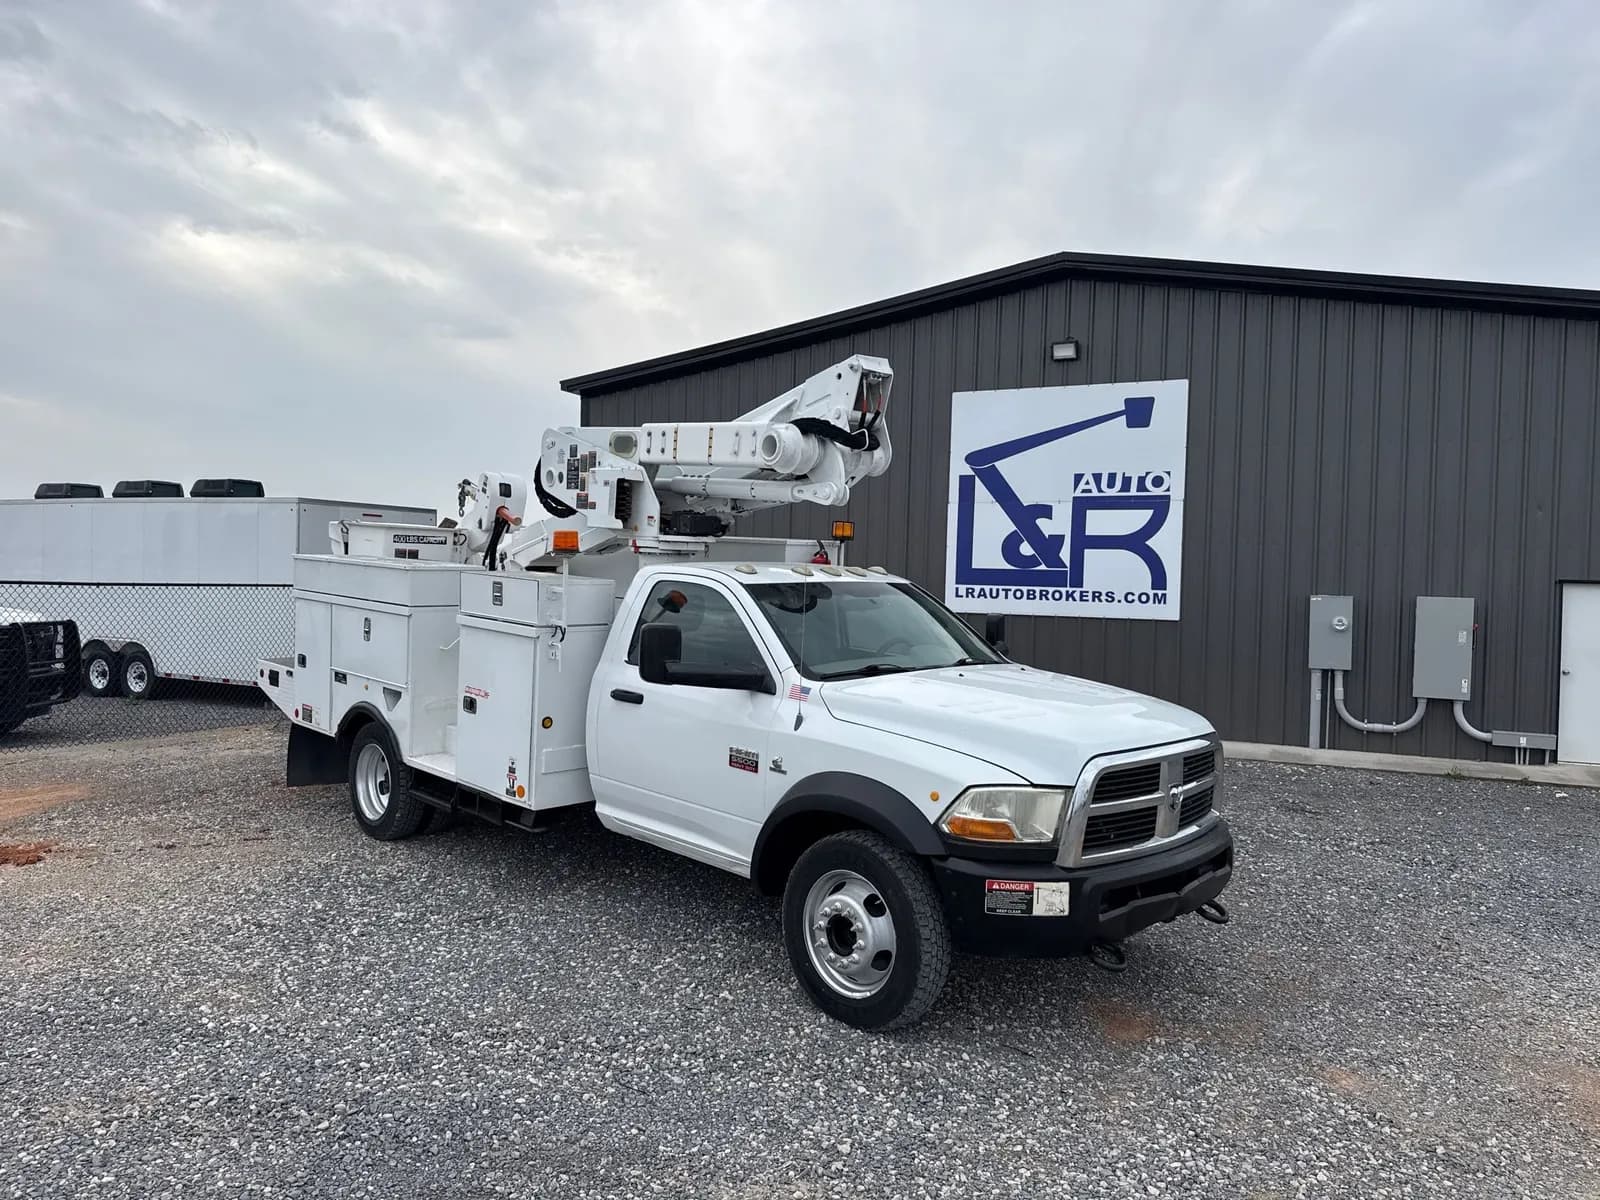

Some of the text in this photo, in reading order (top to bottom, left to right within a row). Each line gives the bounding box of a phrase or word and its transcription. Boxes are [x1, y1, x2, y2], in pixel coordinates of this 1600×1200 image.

[1075, 472, 1170, 494] AUTO
[394, 535, 406, 543] 400
[955, 586, 1168, 605] LRAUTOBROKERS.COM
[1000, 883, 1030, 891] DANGER
